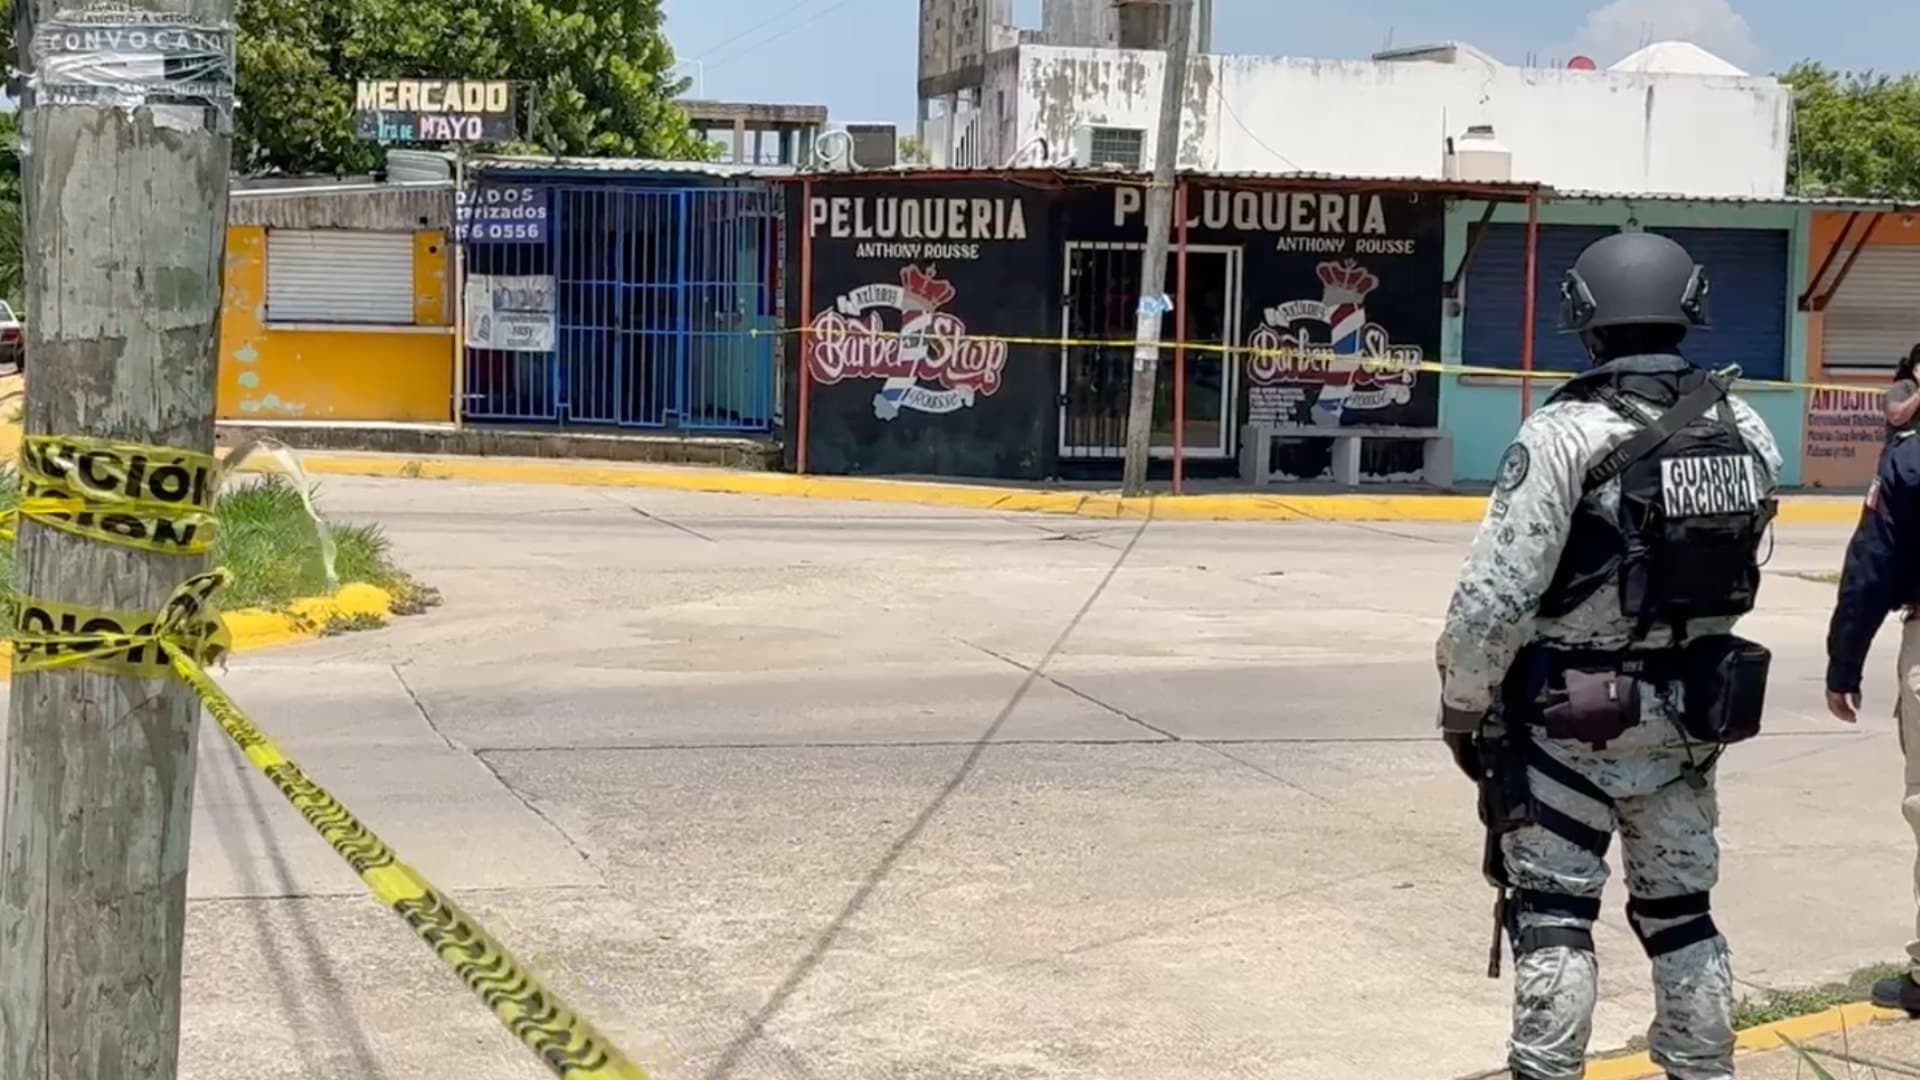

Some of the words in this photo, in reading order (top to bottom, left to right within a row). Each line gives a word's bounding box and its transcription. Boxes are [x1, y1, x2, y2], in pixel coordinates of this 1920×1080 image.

[357, 81, 508, 112] MERCADO
[419, 116, 484, 140] MAYO
[810, 196, 1027, 240] PELUQUERIA
[1114, 186, 1387, 236] PLUQUERIA
[490, 223, 539, 239] 0556
[1276, 236, 1346, 254] ANTHONY
[1355, 238, 1415, 255] ROUSSE
[856, 243, 920, 260] ANTHONY
[924, 243, 980, 260] ROUSSE
[813, 307, 908, 379] Barber
[924, 314, 1008, 384] Shop
[1669, 458, 1748, 487] GUARDIA
[1665, 482, 1756, 516] NACIONAL
